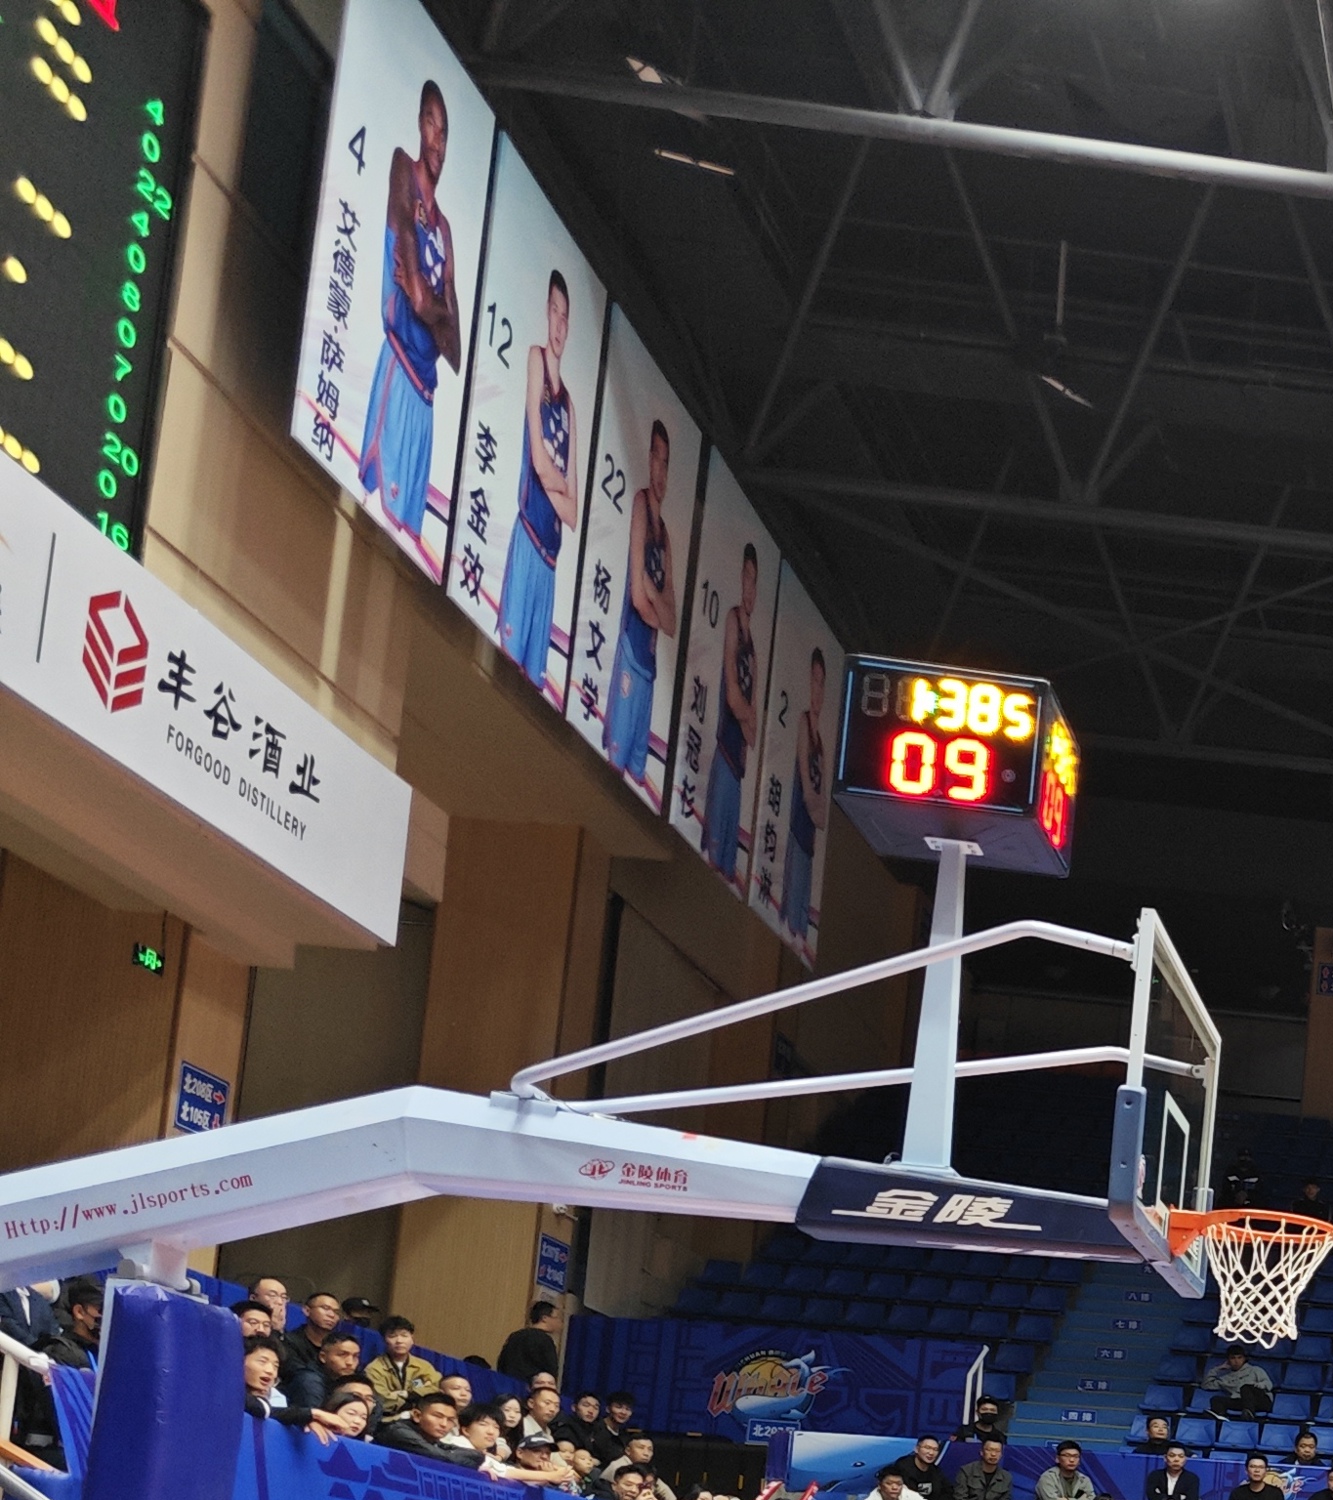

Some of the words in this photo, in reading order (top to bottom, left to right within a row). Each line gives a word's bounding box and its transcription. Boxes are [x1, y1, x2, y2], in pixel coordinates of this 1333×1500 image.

[348, 126, 366, 176] 4
[487, 302, 513, 369] 12
[602, 452, 626, 514] 22
[703, 579, 720, 628] 10
[583, 558, 612, 722] 杨文学
[157, 649, 321, 804] 丰谷酒业
[779, 690, 789, 728] 2
[166, 723, 232, 787] FORGOOD
[238, 776, 307, 841] DISTILLERY
[889, 731, 988, 801] 09
[618, 1179, 652, 1189] JINLING
[621, 1162, 688, 1184] 金陵体育
[846, 1188, 1030, 1230] 金陵
